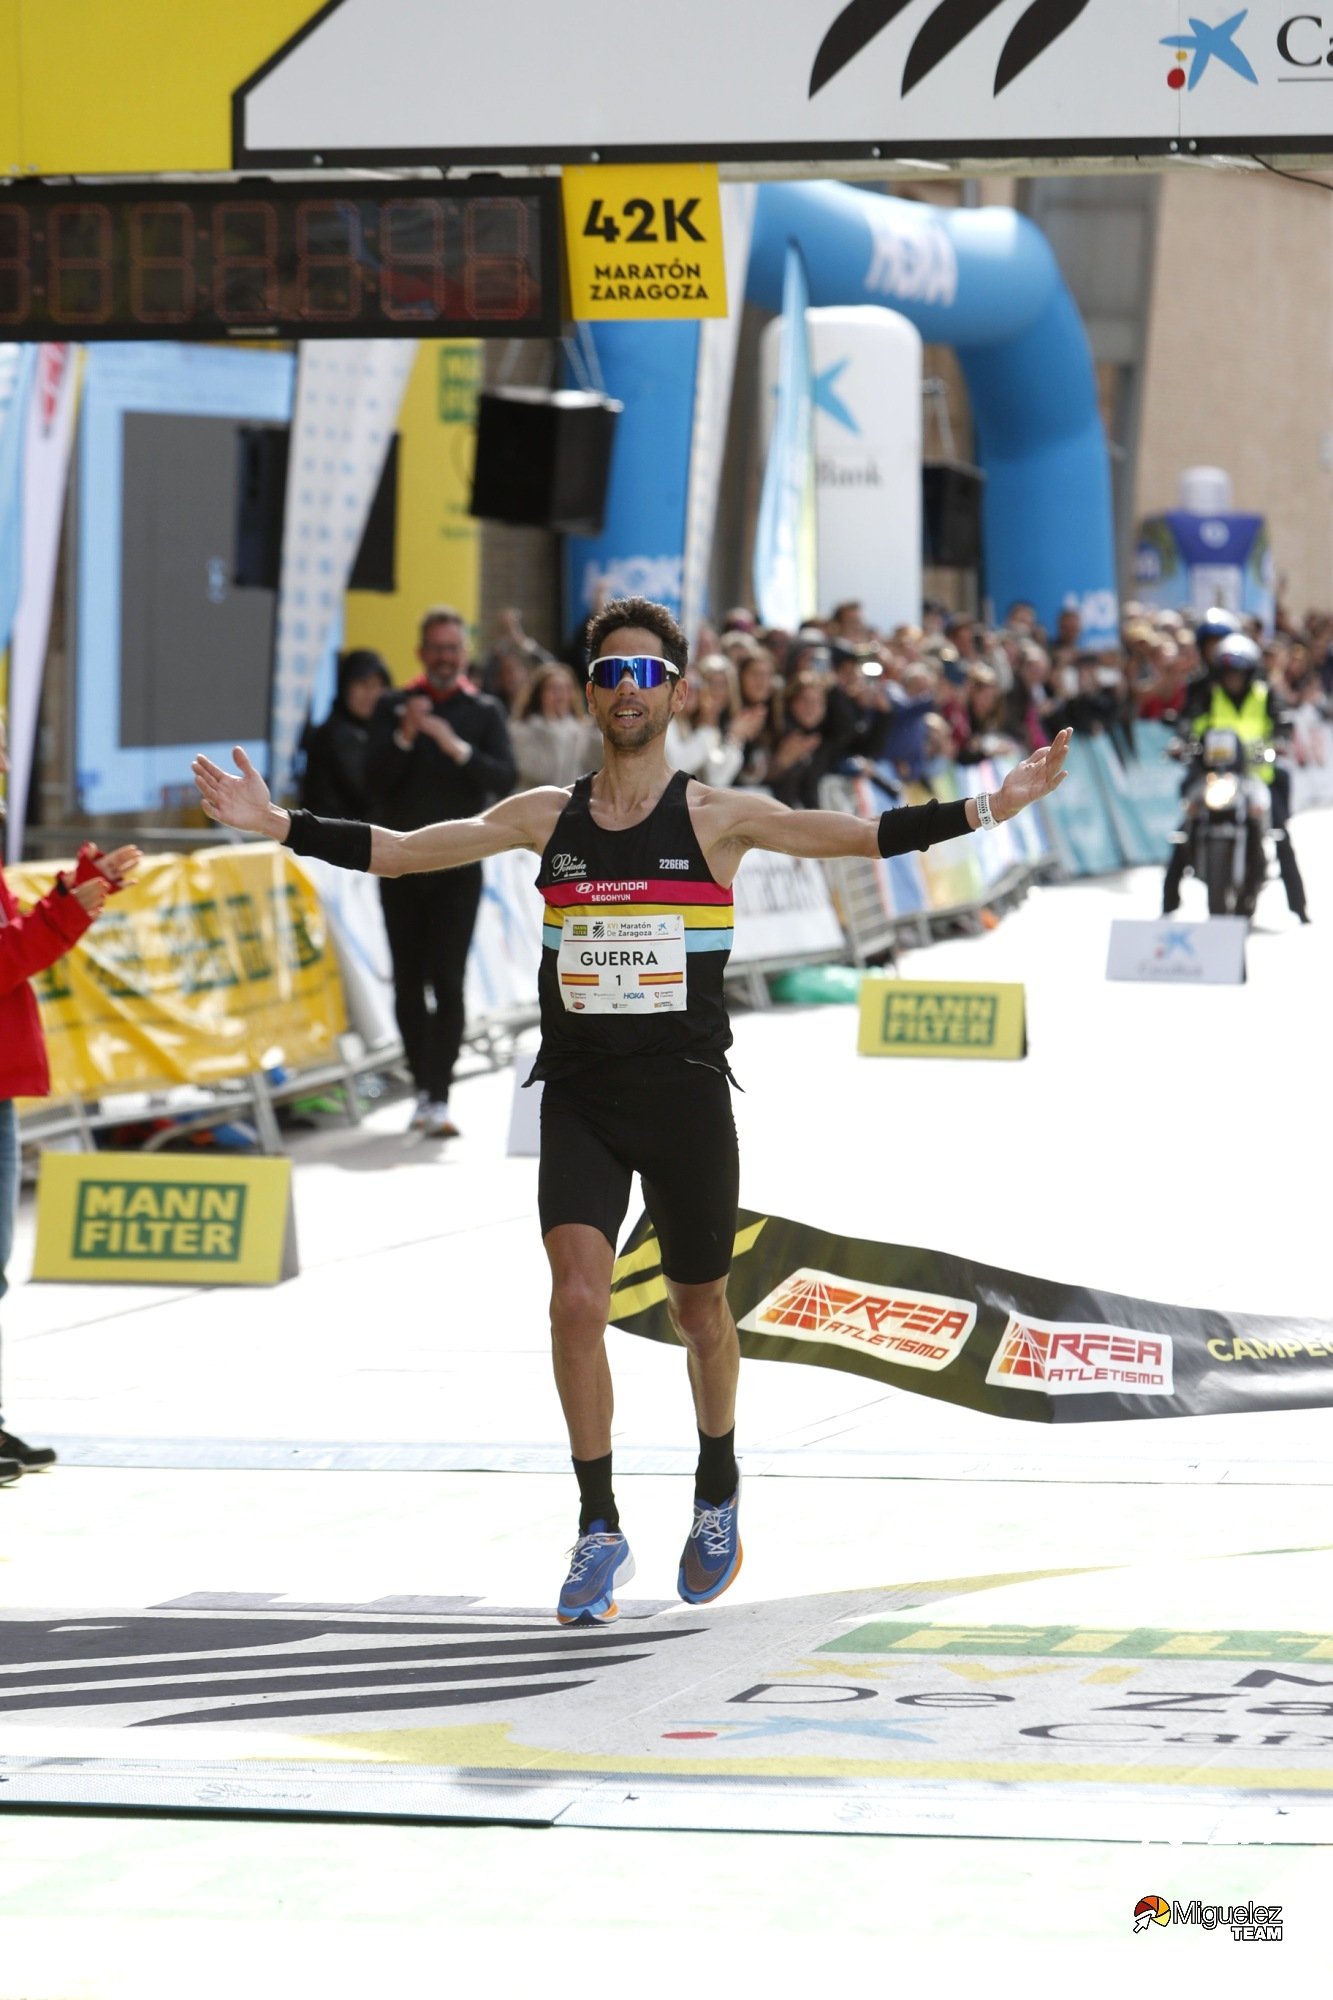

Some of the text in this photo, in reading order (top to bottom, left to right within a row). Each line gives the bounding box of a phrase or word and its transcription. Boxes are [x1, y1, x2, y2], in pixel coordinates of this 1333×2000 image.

[582, 198, 707, 243] 42K
[594, 257, 702, 280] MARATÓN
[589, 284, 710, 302] ZARAGOZA
[659, 858, 690, 870] 226ERS
[596, 881, 648, 892] HYUNDAI
[591, 893, 631, 902] SEGOHYUN
[618, 930, 652, 938] Zaragoza
[620, 922, 652, 930] Maratón
[580, 950, 659, 967] GUERRA
[615, 974, 622, 986] 1
[623, 991, 645, 1000] HOKA
[890, 997, 995, 1019] MANN
[886, 1018, 992, 1043] FILTER
[84, 1185, 240, 1221] MANN
[79, 1220, 235, 1255] FILTER
[844, 1295, 970, 1340] RFEA
[823, 1320, 951, 1361] ATLETISMO
[1049, 1333, 1163, 1366] RFEA
[1047, 1367, 1165, 1386] ATLETISMO
[724, 1683, 1016, 1708] De
